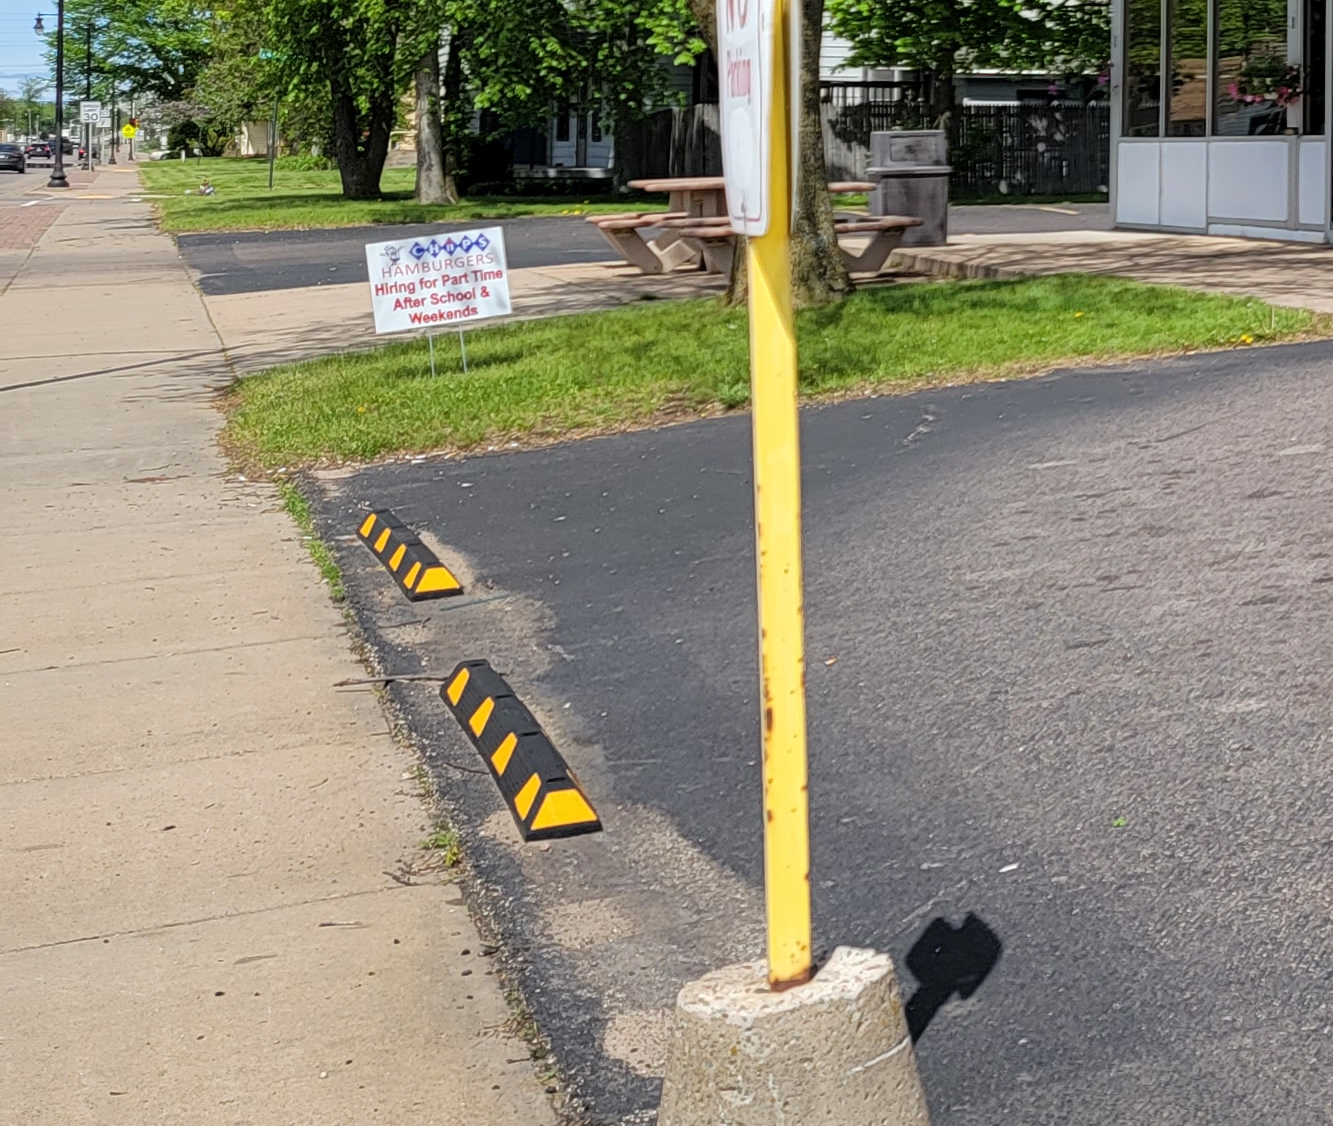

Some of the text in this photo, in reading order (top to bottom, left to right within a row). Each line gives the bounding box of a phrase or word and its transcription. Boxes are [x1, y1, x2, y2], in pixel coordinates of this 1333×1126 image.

[83, 113, 99, 121] 30
[411, 234, 489, 259] CHIPS
[381, 253, 494, 279] HAMBURGERS
[374, 269, 504, 296] Hiring for Part Time
[393, 286, 490, 311] After School &
[408, 305, 479, 324] Weekends
